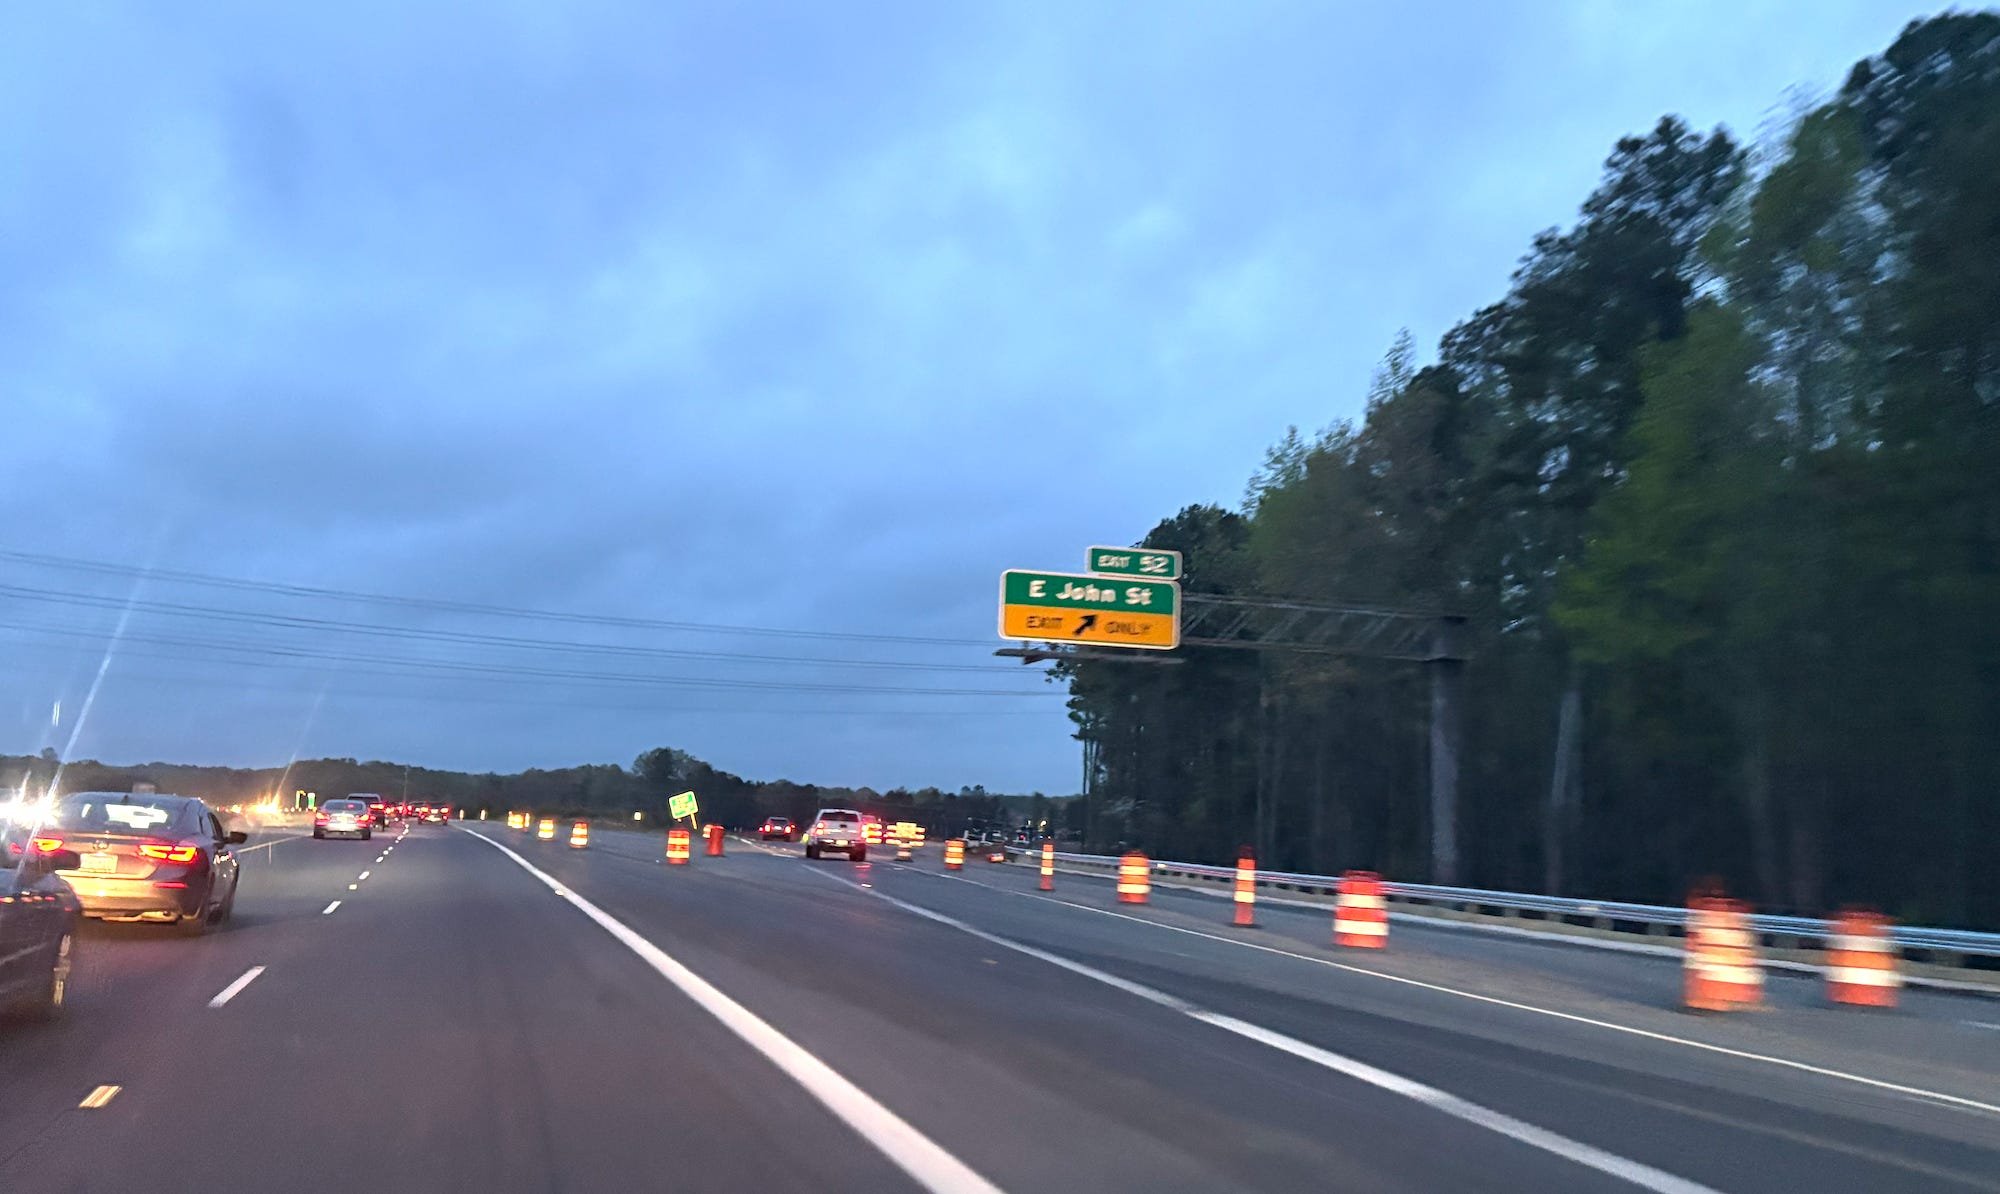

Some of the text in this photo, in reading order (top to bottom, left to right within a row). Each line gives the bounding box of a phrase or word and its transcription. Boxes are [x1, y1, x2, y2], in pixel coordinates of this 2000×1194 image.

[1097, 554, 1169, 573] EXIT 52
[1028, 579, 1153, 606] E John St
[1026, 615, 1153, 635] EXIT ONLY
